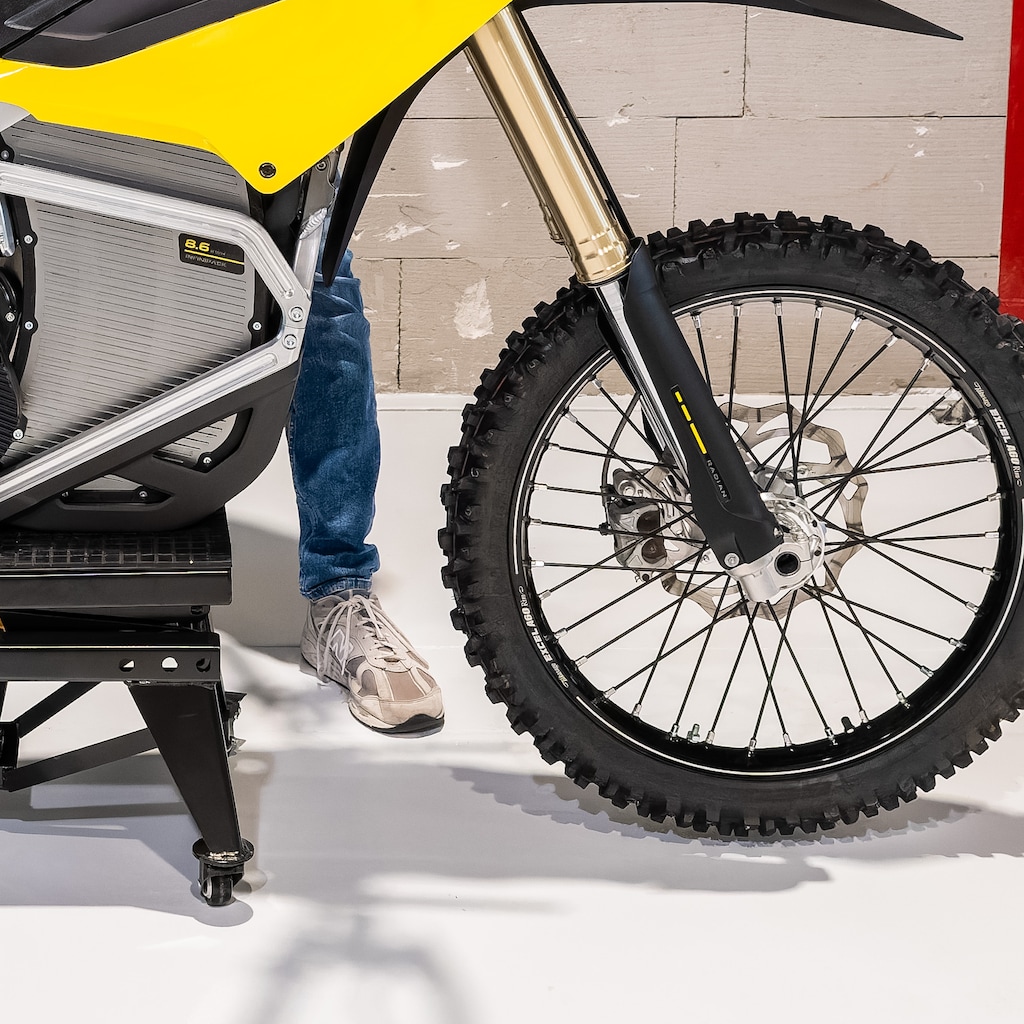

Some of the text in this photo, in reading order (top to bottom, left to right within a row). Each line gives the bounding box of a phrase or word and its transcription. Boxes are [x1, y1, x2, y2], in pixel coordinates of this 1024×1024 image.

[184, 238, 211, 252] 8.6
[989, 407, 1012, 444] EXCEL
[706, 459, 727, 498] RADIAN
[521, 606, 536, 628] A60
[531, 627, 553, 663] EXCEL
